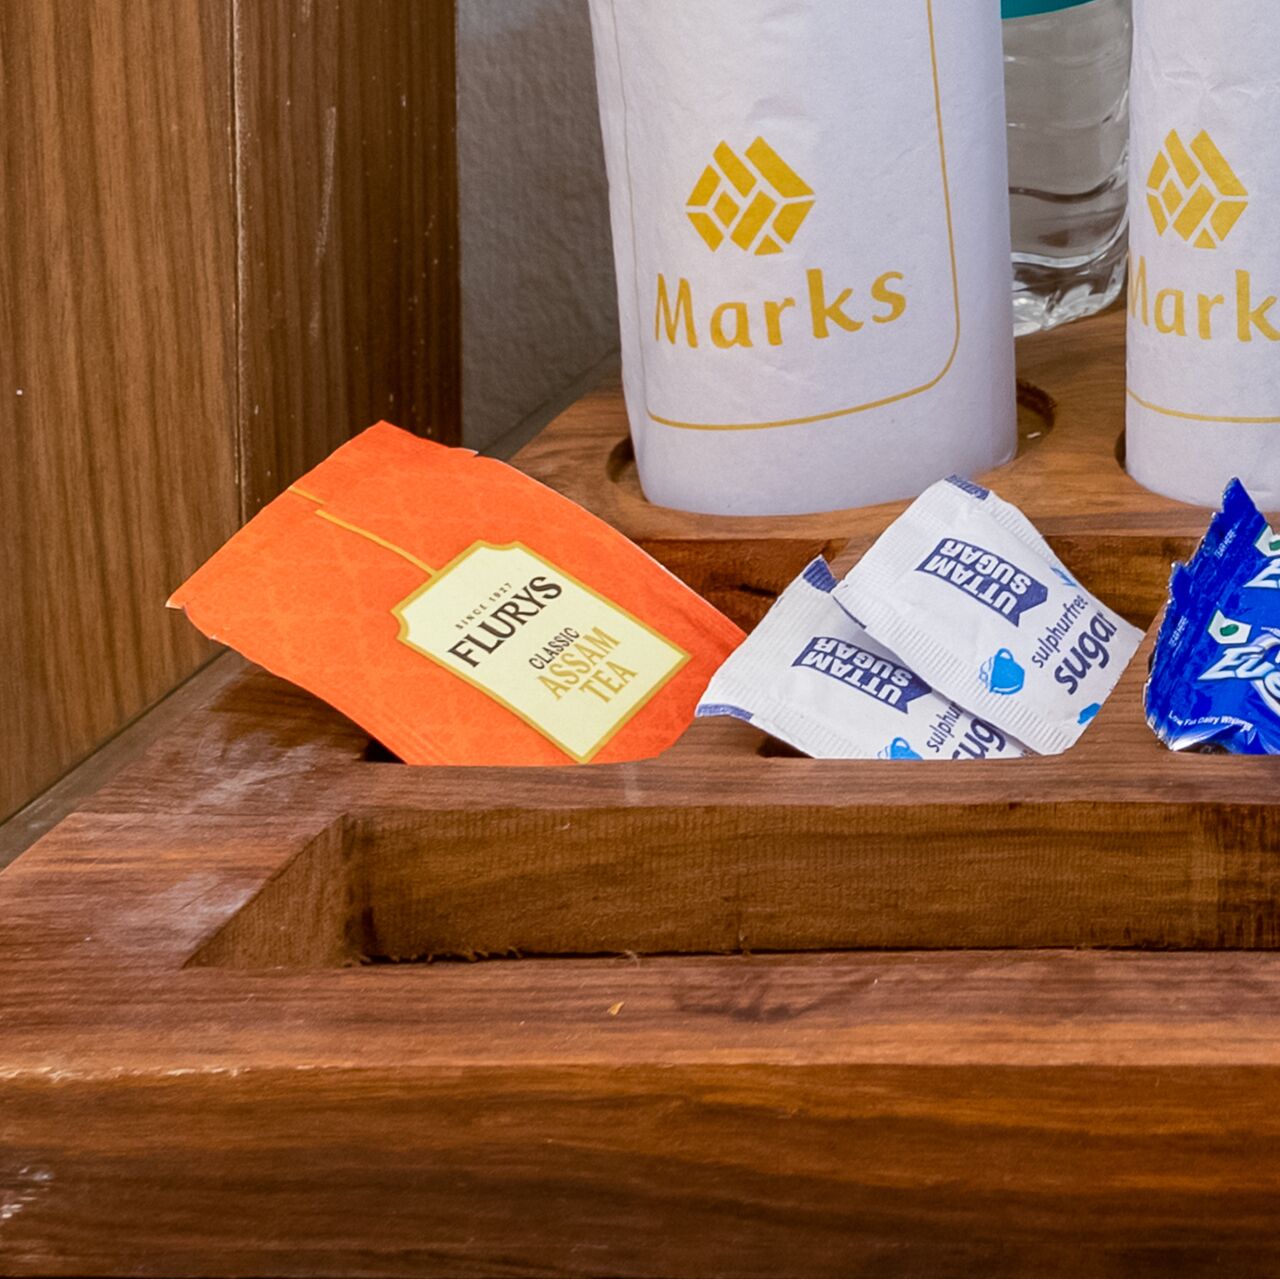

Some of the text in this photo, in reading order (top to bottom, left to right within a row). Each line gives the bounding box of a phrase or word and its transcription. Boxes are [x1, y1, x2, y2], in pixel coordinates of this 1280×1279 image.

[655, 268, 906, 349] Marks
[923, 555, 1018, 615] UTTAM
[940, 540, 1032, 595] SUGAR
[447, 576, 563, 668] FLURYS
[529, 627, 580, 670] CLASSIC
[1032, 595, 1088, 668] sulphurfree
[537, 626, 621, 701] ASSAM
[578, 661, 639, 703] TEA
[801, 651, 902, 705] UTTAM
[813, 638, 912, 687] SUGAR
[1054, 609, 1117, 696] sugar
